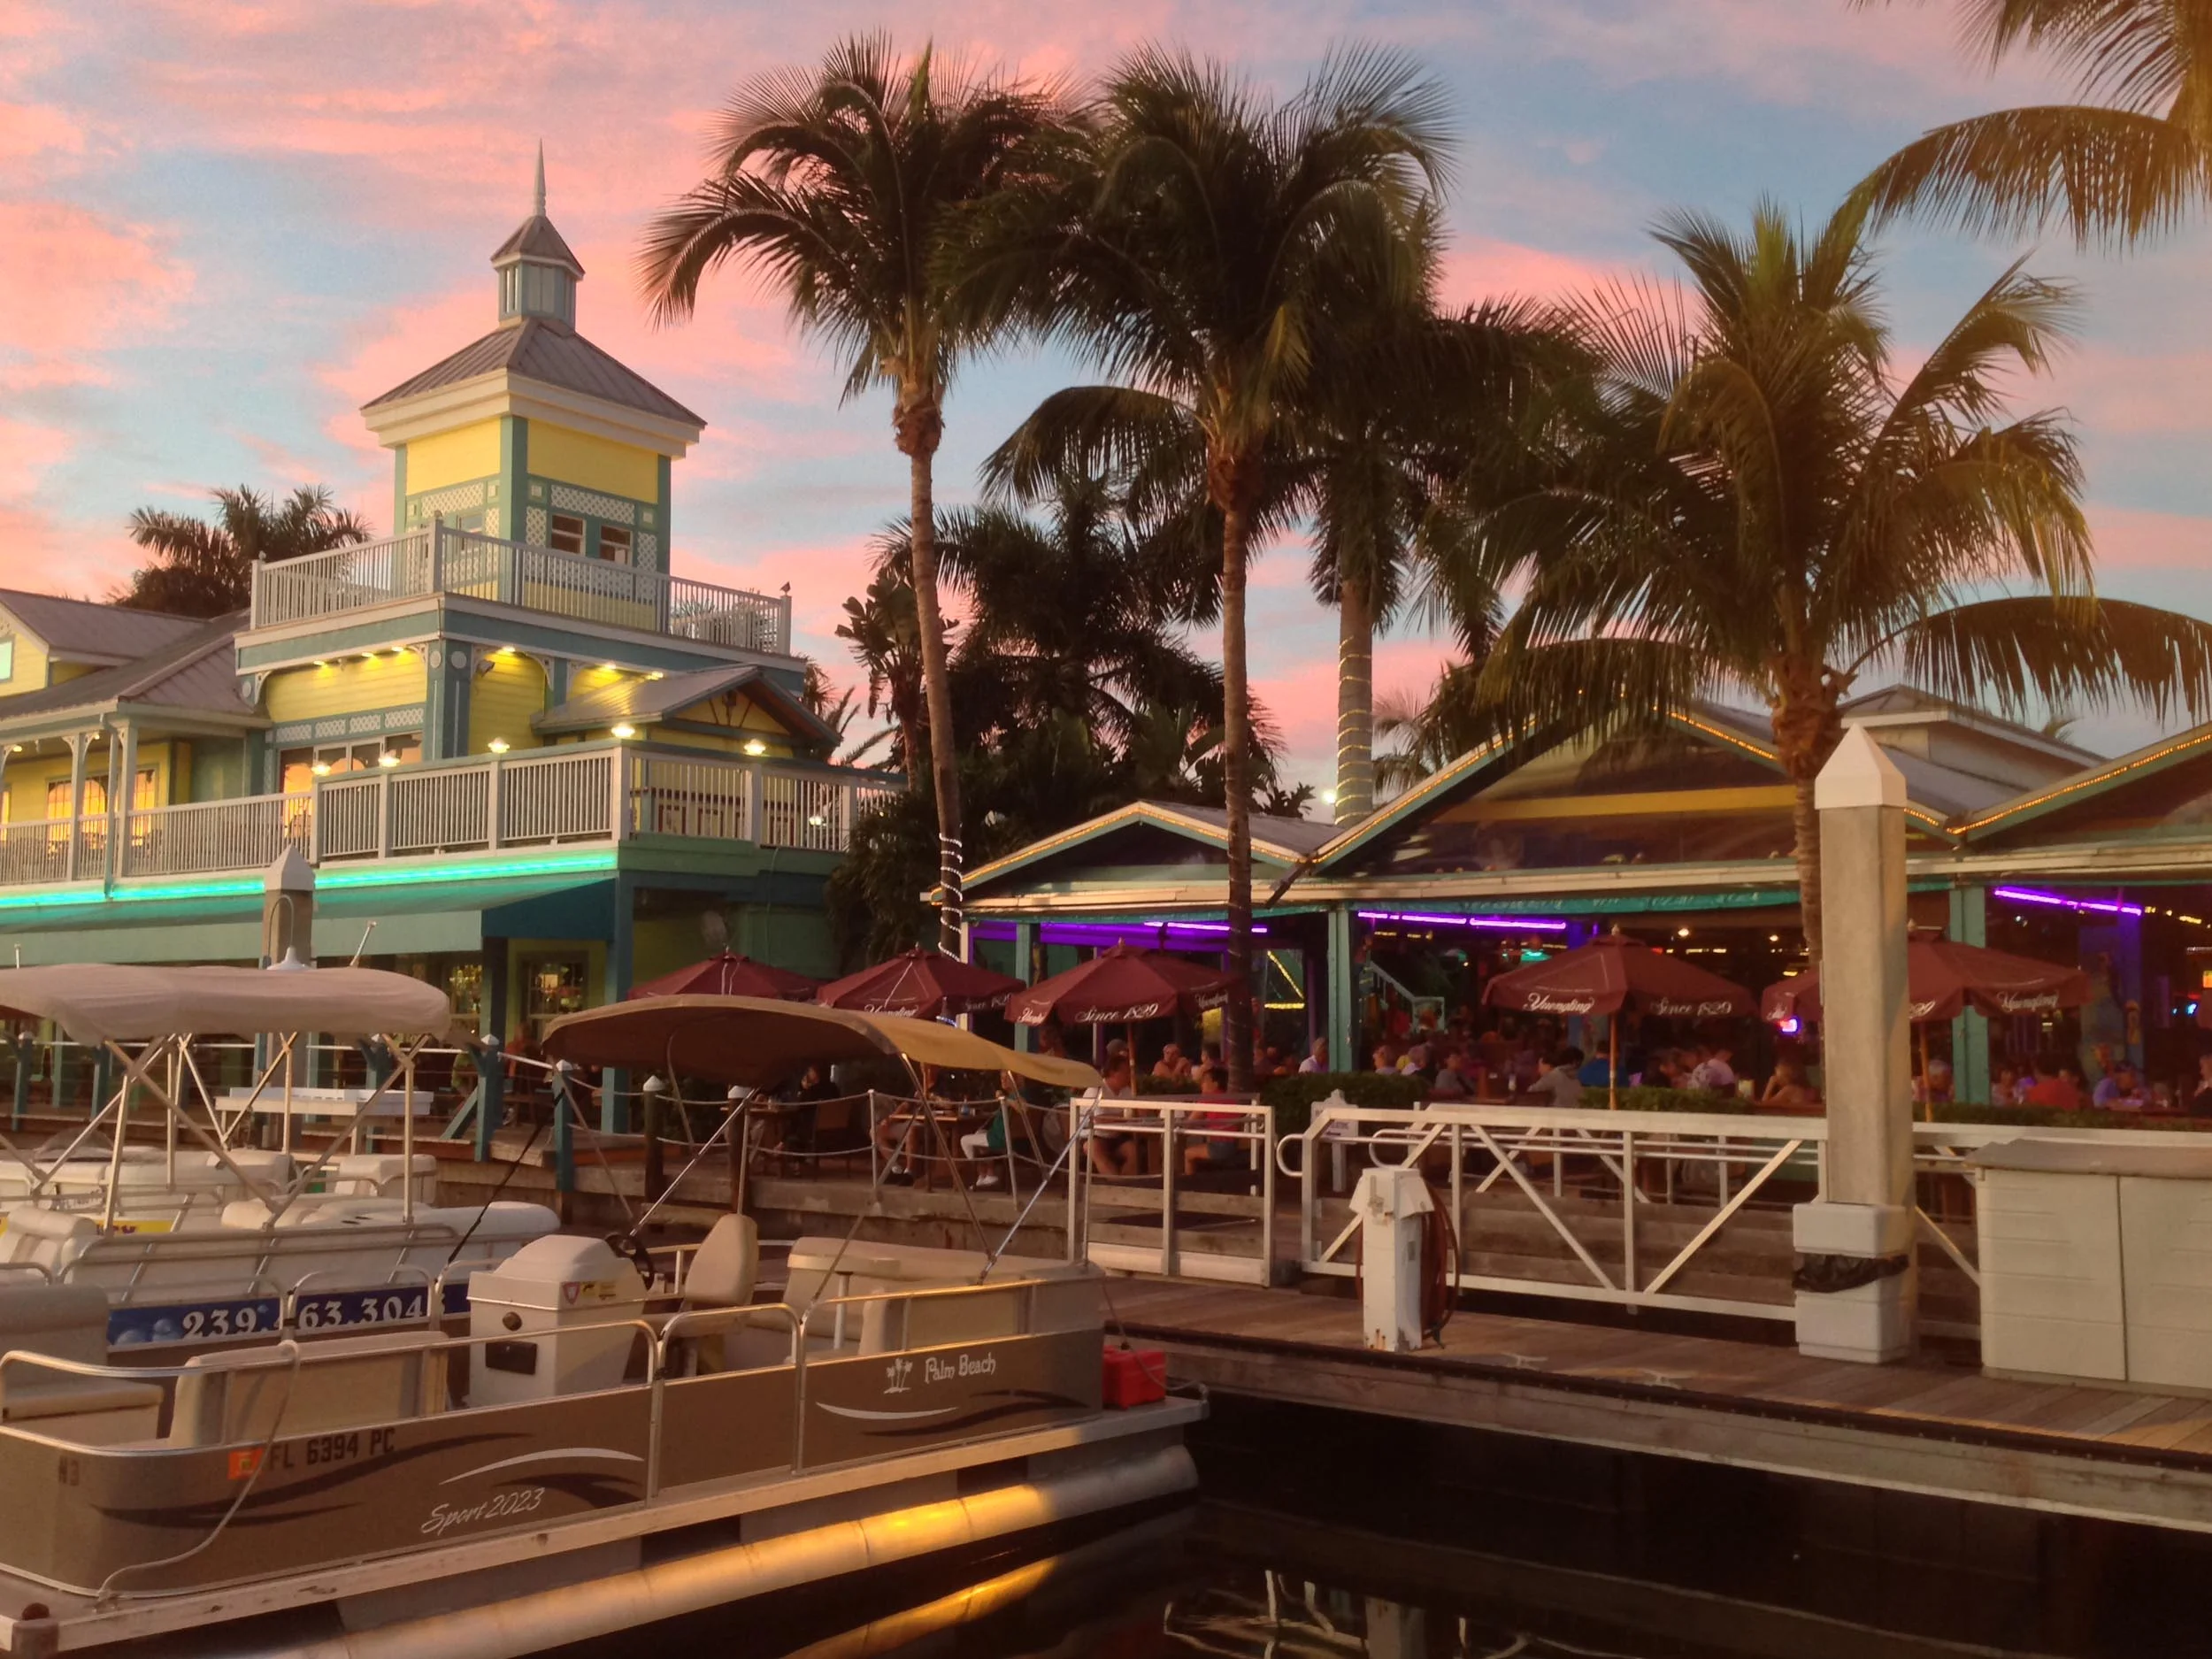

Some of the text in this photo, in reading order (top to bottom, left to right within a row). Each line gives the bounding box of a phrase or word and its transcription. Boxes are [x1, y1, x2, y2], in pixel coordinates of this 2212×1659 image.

[1075, 1002, 1159, 1023] Since 1829
[1523, 992, 1595, 1014] Yuengling
[1650, 996, 1732, 1017] Since 1829
[924, 1351, 996, 1385] Palm Beach
[269, 1427, 395, 1470] FL 6394 PC
[420, 1486, 545, 1536] Sport 2023
